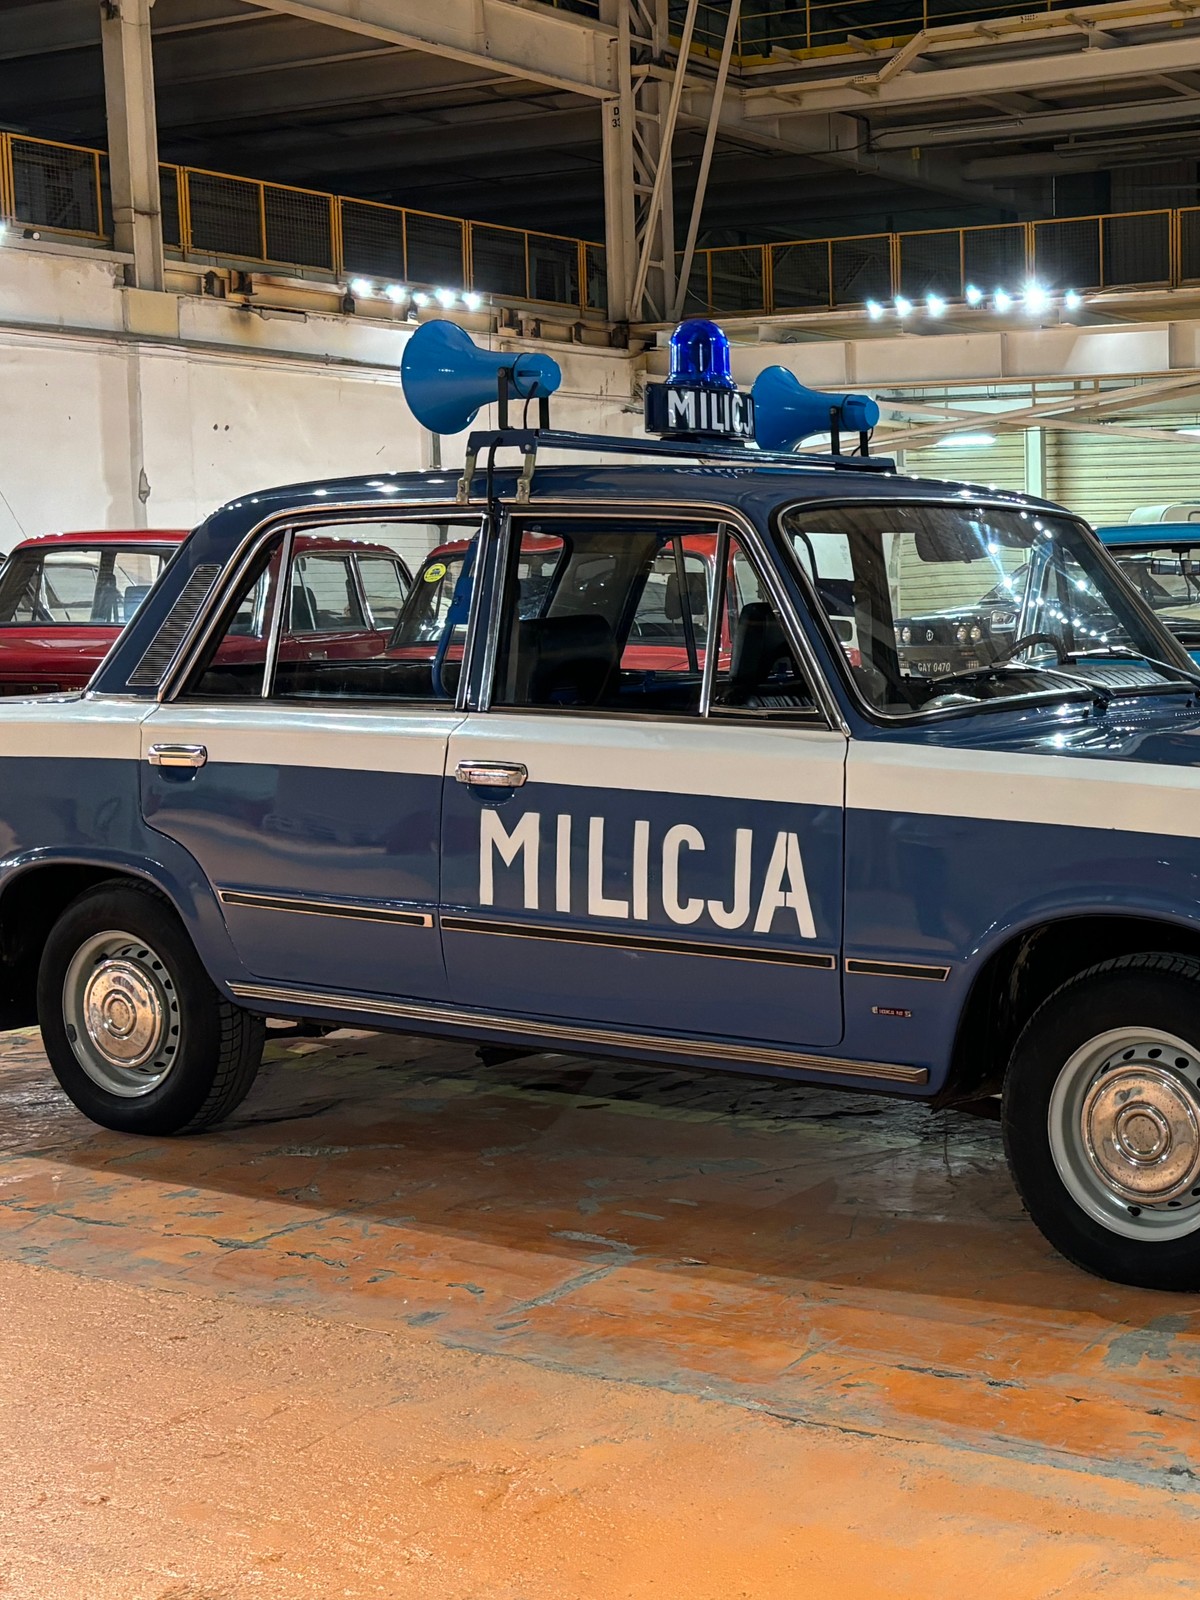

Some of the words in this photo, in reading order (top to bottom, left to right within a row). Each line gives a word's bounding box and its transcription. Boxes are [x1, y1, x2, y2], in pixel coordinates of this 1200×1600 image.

[614, 106, 620, 116] D
[667, 389, 754, 435] MILICJ
[933, 662, 951, 673] 0470
[479, 808, 818, 939] MILICJA
